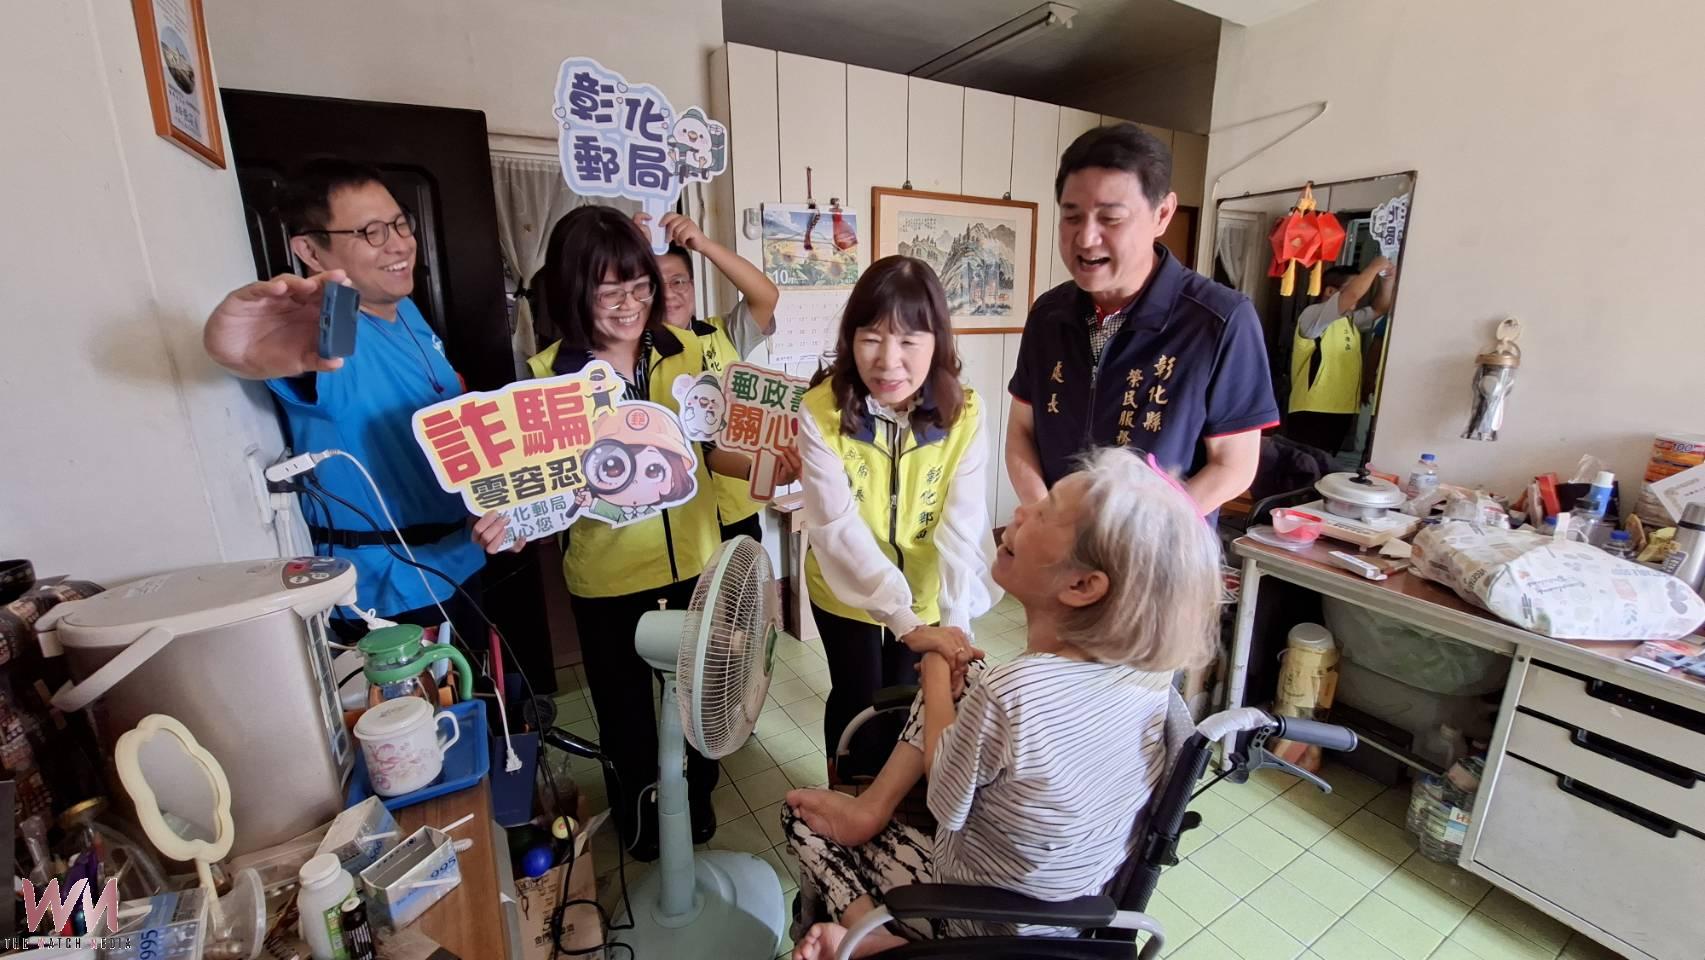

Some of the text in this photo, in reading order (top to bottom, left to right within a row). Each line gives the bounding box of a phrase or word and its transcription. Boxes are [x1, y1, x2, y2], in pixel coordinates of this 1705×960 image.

[569, 72, 665, 142] 彰化
[574, 136, 672, 191] 郵局
[1047, 361, 1064, 413] 處長
[1142, 354, 1176, 432] 彰化縣
[422, 382, 592, 484] 詐騙
[726, 403, 798, 448] 關心
[470, 455, 582, 509] 零容忍
